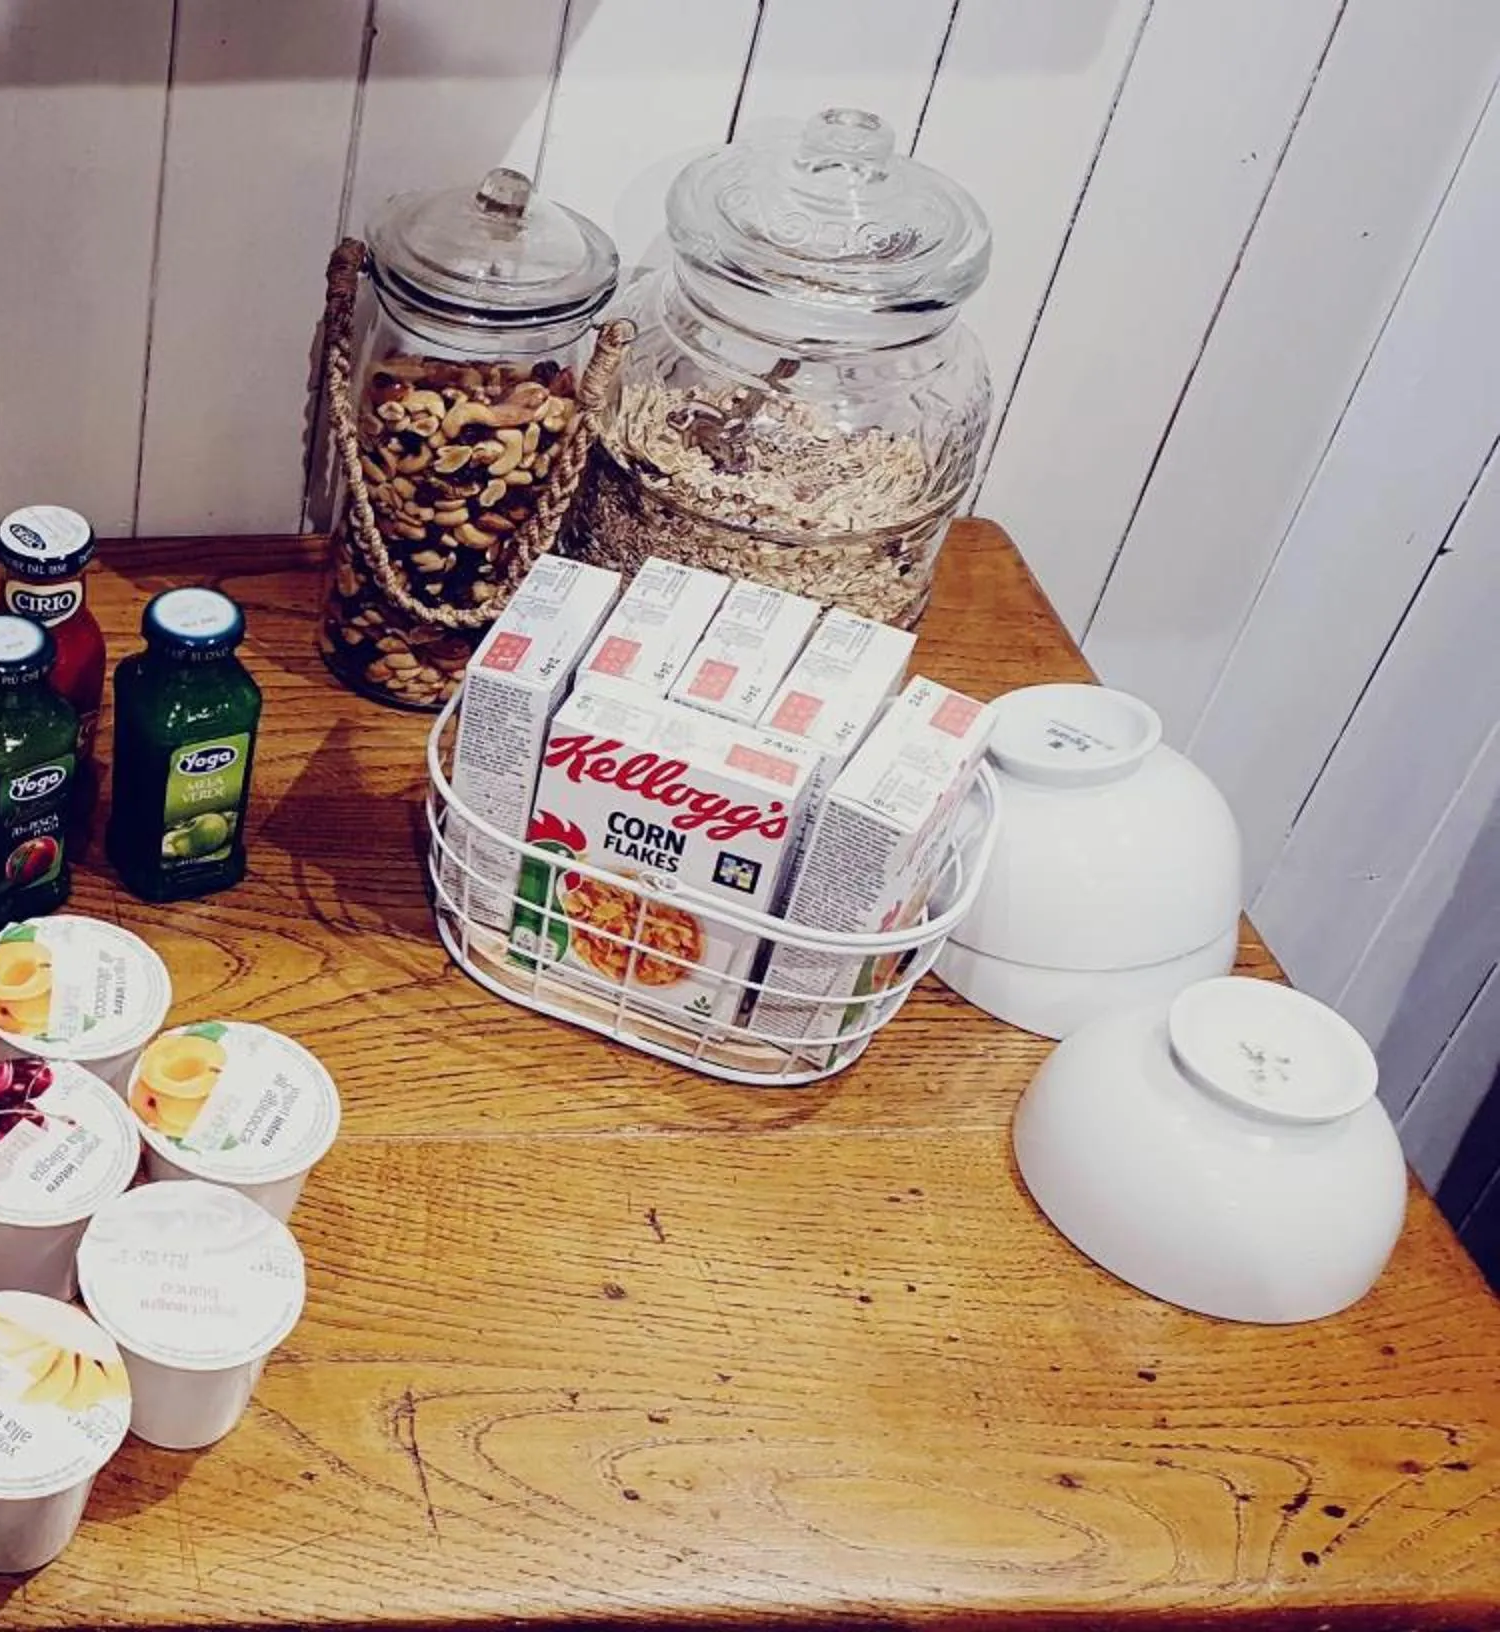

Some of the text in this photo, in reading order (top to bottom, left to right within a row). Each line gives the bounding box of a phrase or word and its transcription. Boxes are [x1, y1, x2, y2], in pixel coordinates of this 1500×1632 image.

[15, 593, 73, 612] CIRIO
[181, 750, 232, 772] Yoga
[11, 771, 60, 797] Yoga
[545, 735, 789, 841] Kellogg's
[607, 811, 688, 856] CORN
[603, 834, 681, 873] FLAKES
[3, 1418, 33, 1444] alla
